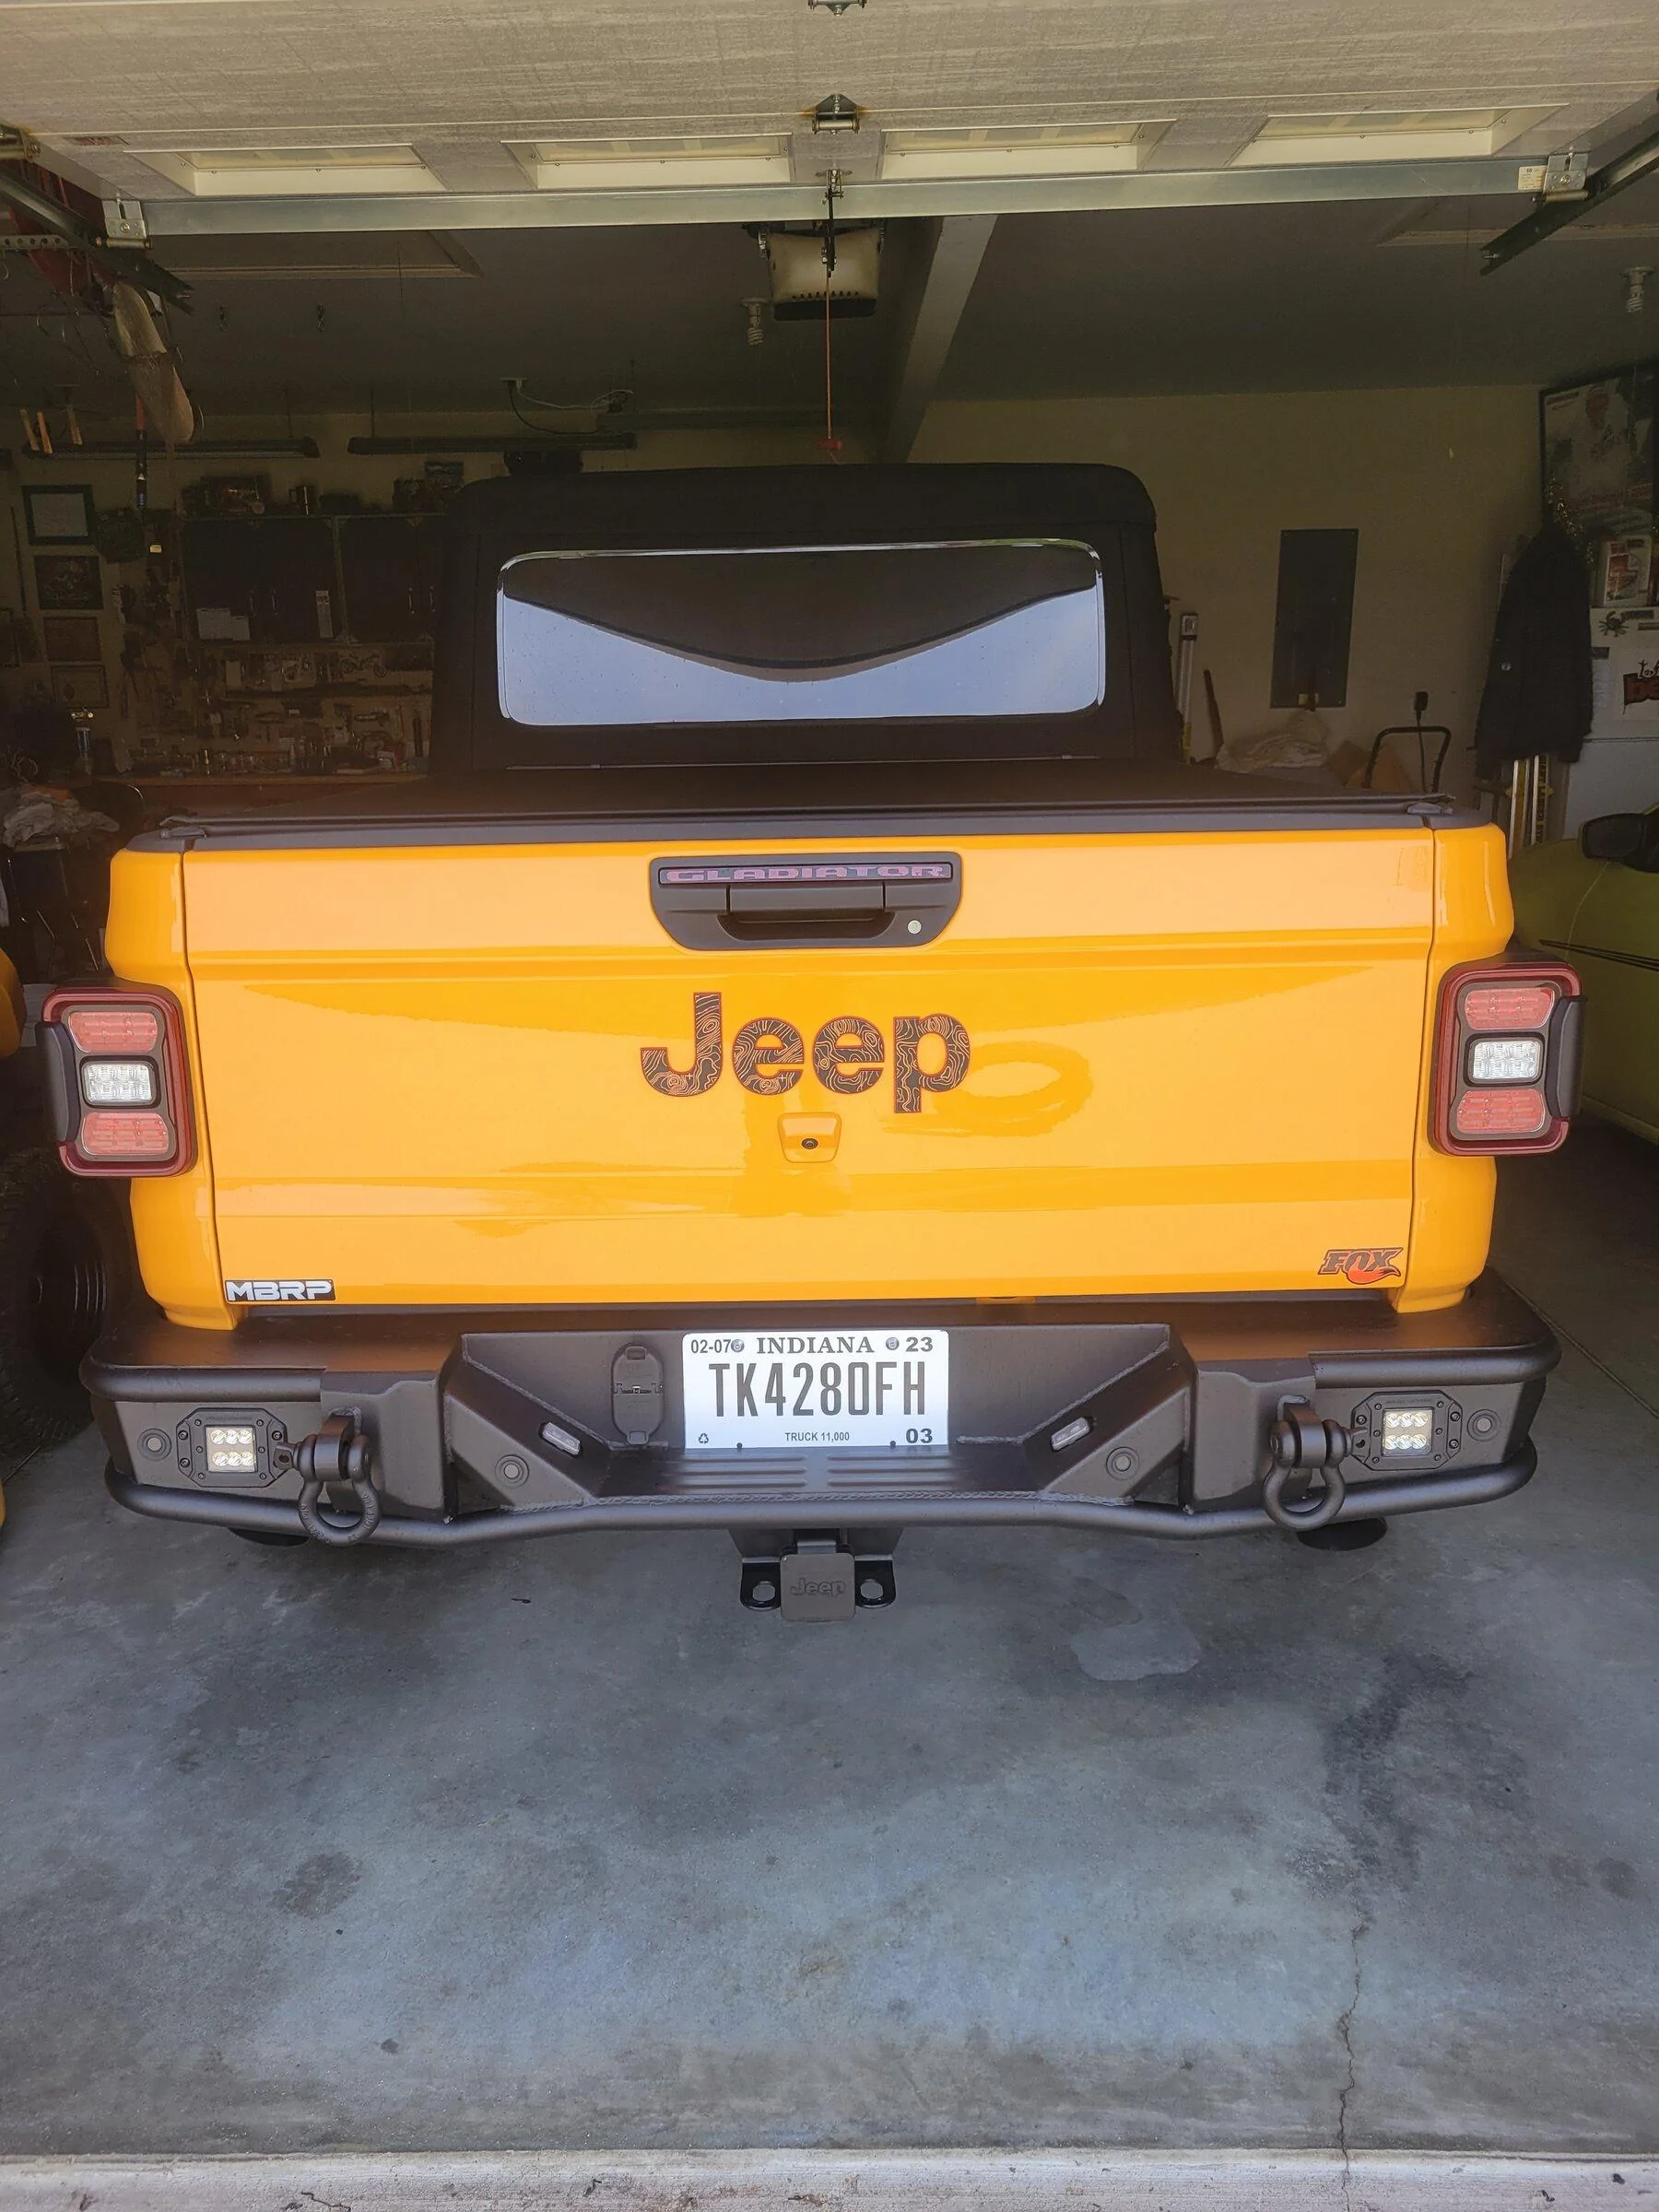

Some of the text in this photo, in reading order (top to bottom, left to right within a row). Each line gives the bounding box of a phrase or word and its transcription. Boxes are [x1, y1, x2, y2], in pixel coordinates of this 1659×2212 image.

[666, 865, 946, 883] GLADIATOR
[641, 992, 971, 1113] Jeep
[1318, 1247, 1403, 1279] FOX
[225, 1279, 334, 1301] MBRP
[690, 1338, 731, 1354] 02-07
[756, 1336, 875, 1354] INDIANA
[905, 1336, 934, 1353] 23
[708, 1360, 925, 1418] TK4280FH
[784, 1431, 850, 1442] TRUCK 11,000
[905, 1428, 933, 1444] 03
[789, 1576, 847, 1598] Jeep
